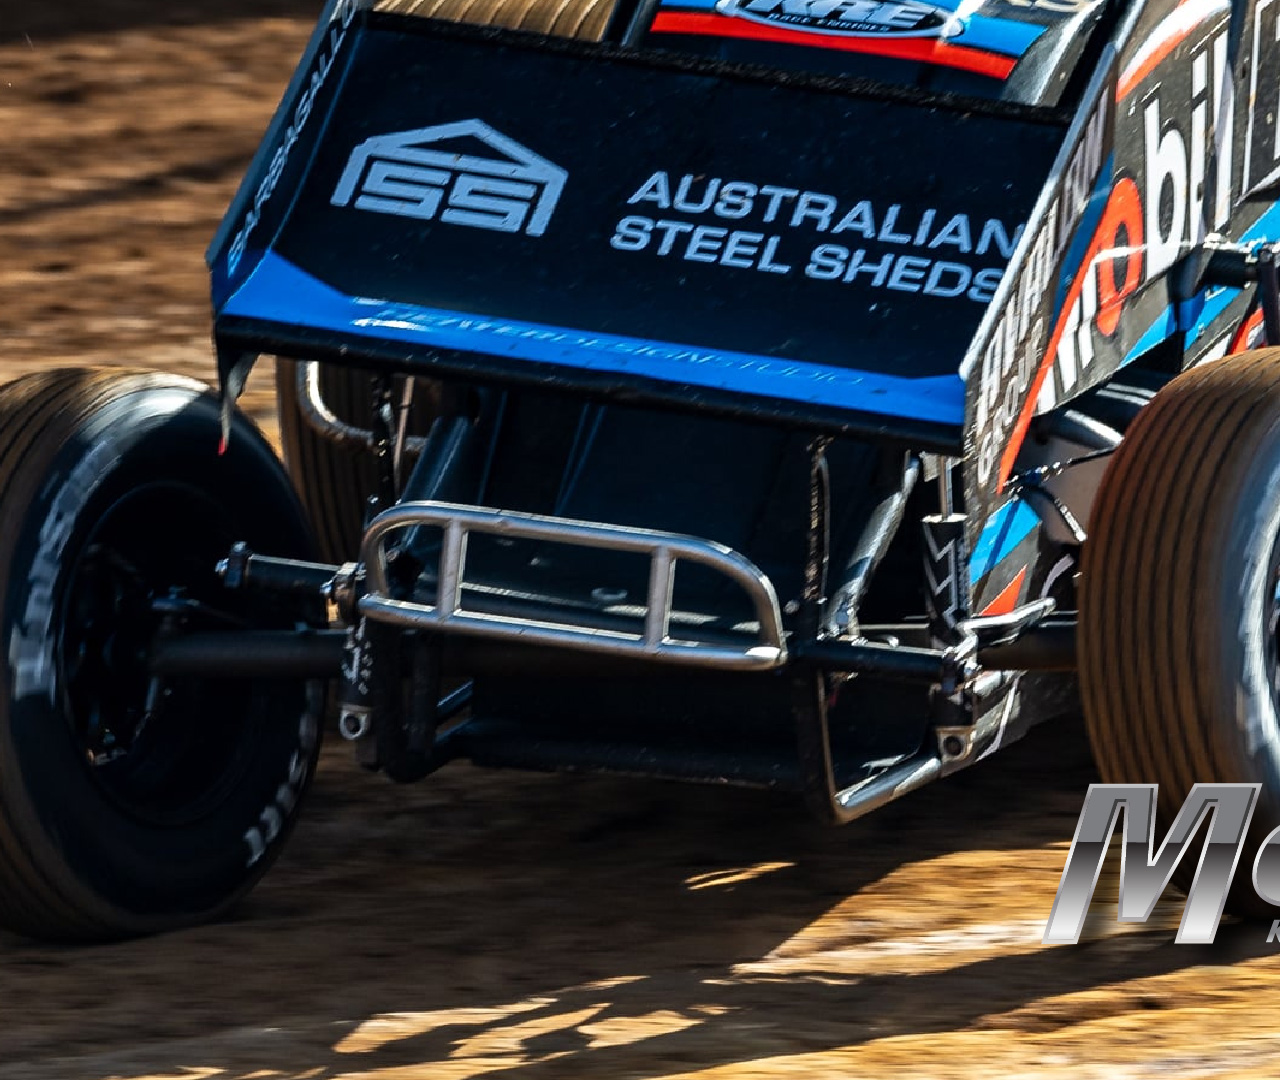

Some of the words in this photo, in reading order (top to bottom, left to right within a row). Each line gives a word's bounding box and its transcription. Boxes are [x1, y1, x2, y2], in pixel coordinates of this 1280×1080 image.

[627, 170, 1024, 258] AUSTRALIAN
[610, 215, 792, 274] STEEL
[804, 243, 1007, 303] SHEDS
